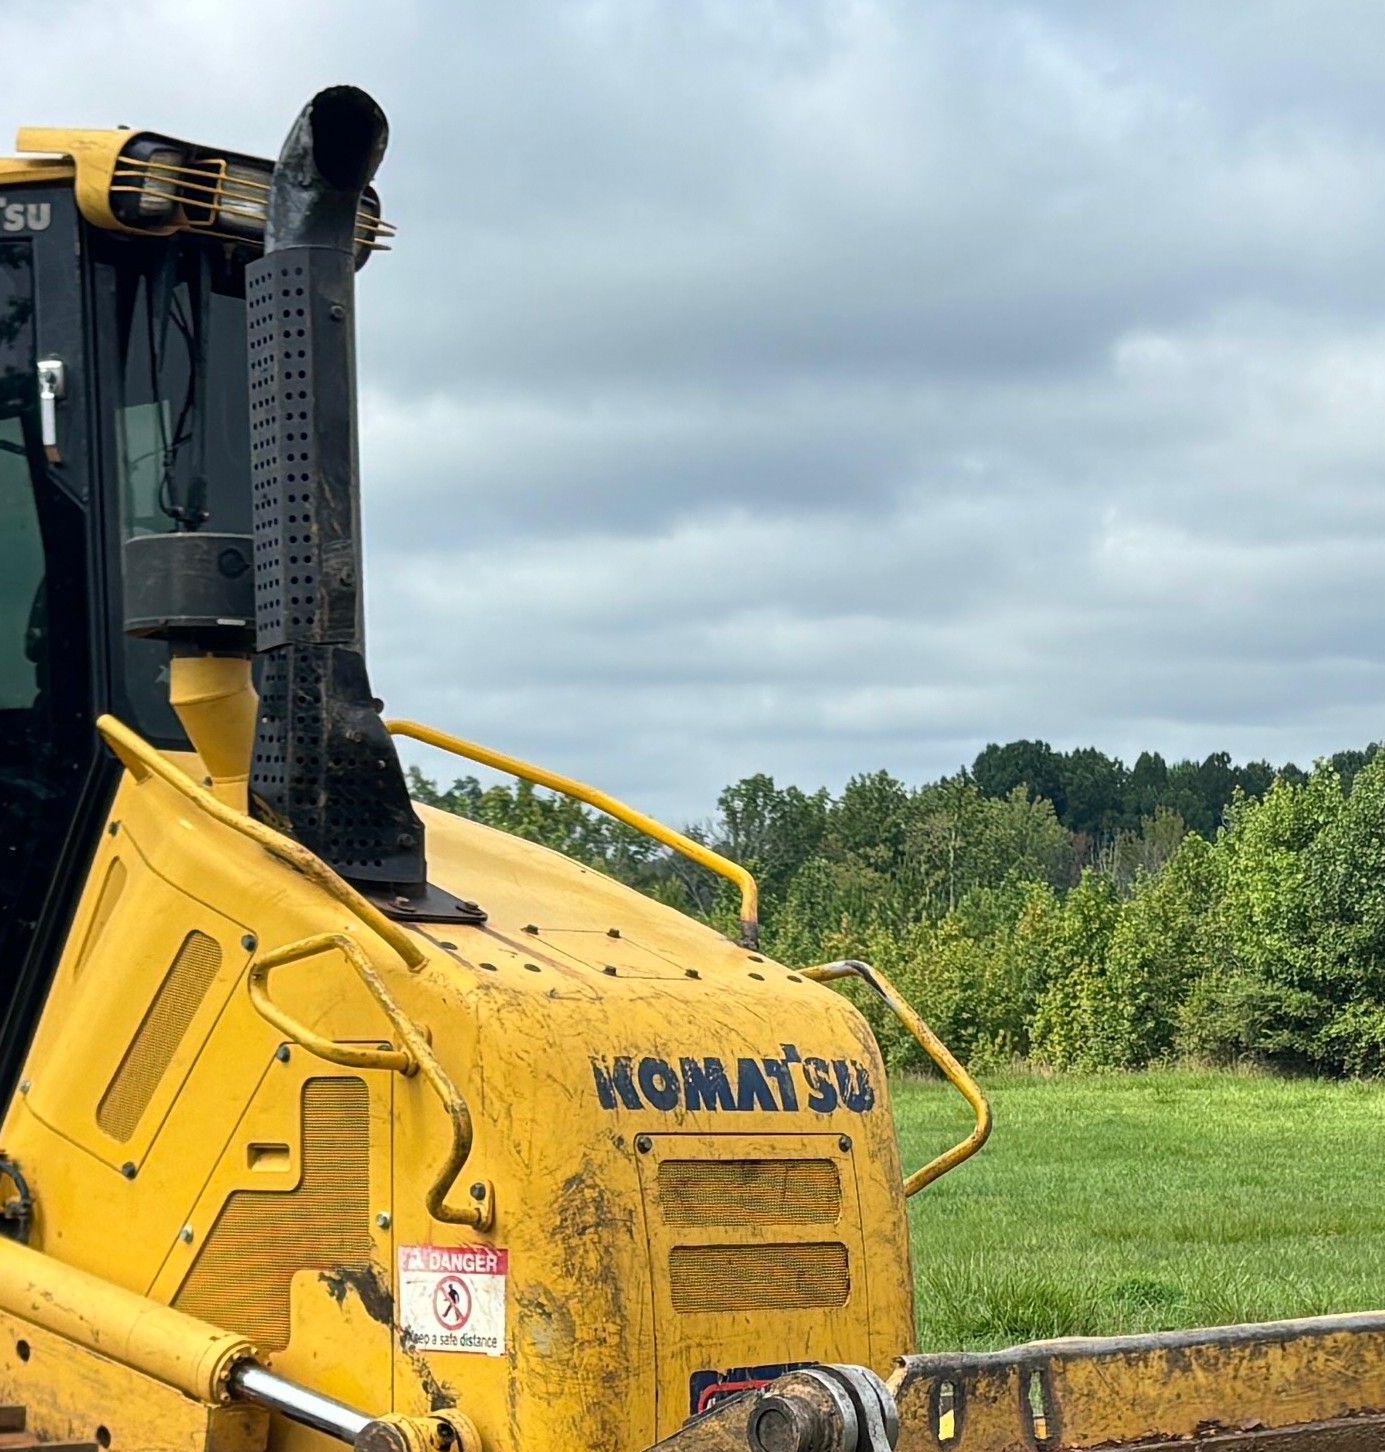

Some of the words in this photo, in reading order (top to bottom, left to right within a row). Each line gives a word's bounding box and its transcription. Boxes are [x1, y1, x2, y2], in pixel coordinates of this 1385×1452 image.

[590, 1043, 874, 1113] KOMATSU
[429, 1252, 498, 1272] DANGER
[431, 1333, 437, 1345] a
[460, 1333, 498, 1349] distance
